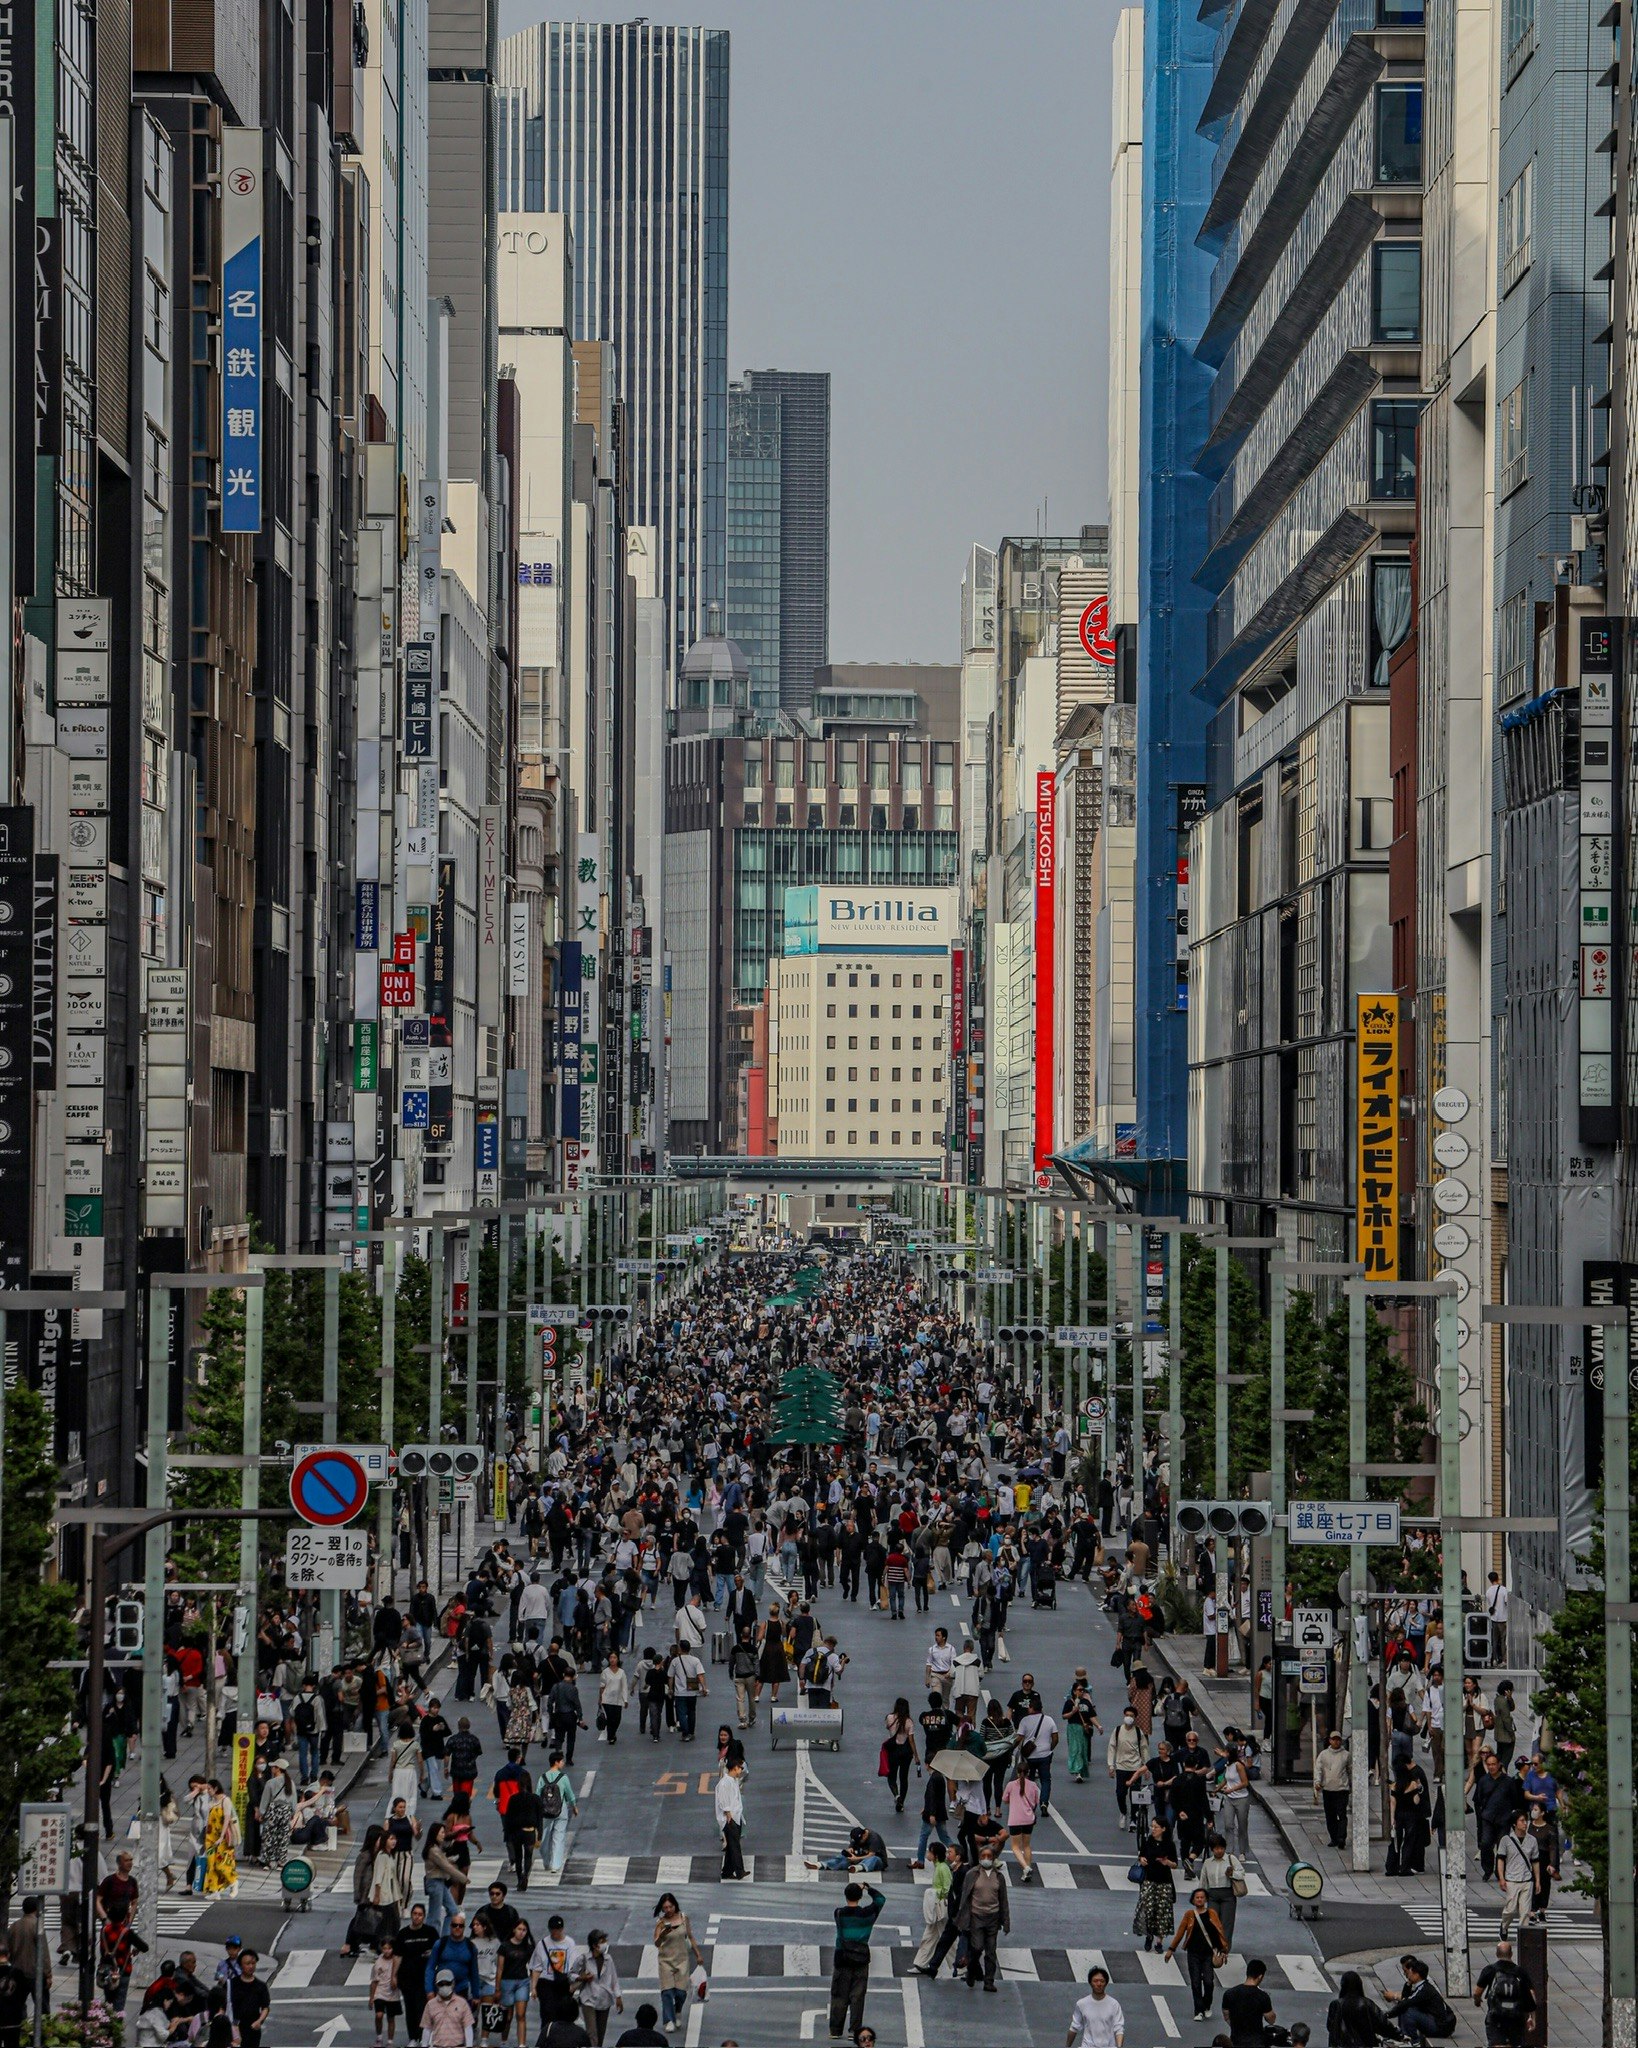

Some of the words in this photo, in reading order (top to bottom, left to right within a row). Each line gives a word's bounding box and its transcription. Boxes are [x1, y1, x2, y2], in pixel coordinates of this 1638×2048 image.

[226, 290, 257, 496] 名鉄観光
[411, 684, 427, 755] 岩崎ビル
[1039, 780, 1052, 887] MITSUKOSHI
[484, 817, 496, 945] EXITMELSA
[829, 899, 939, 921] Brillia
[577, 856, 598, 981] 教文館
[830, 923, 852, 931] NEW
[514, 914, 526, 987] TASAKI
[151, 975, 184, 983] UEMATSU
[384, 976, 409, 988] UNI
[170, 986, 184, 994] BLD
[384, 990, 411, 1004] QLO
[150, 1018, 184, 1027] 法律事務所
[564, 990, 579, 1086] 山野楽器
[68, 1050, 98, 1058] FLOAT
[359, 1024, 371, 1089] 西銀座診療所
[410, 1057, 421, 1080] 買取
[431, 1124, 446, 1137] 6F
[483, 1128, 492, 1165] PLAZA
[1362, 1042, 1393, 1272] ライオンビヤホール
[1570, 1157, 1595, 1169] 防音
[1570, 1170, 1595, 1178] MSK
[530, 1310, 575, 1318] 銀座六丁目
[1058, 1330, 1108, 1341] 銀座六丁目
[1296, 1503, 1326, 1512] 中央区
[1296, 1512, 1392, 1530] 銀座七丁目
[1325, 1531, 1353, 1540] Ginza
[1356, 1531, 1363, 1540] 7
[290, 1552, 363, 1567] タクシーの客待ち
[289, 1569, 325, 1582] を除く
[1298, 1613, 1329, 1622] TAXI
